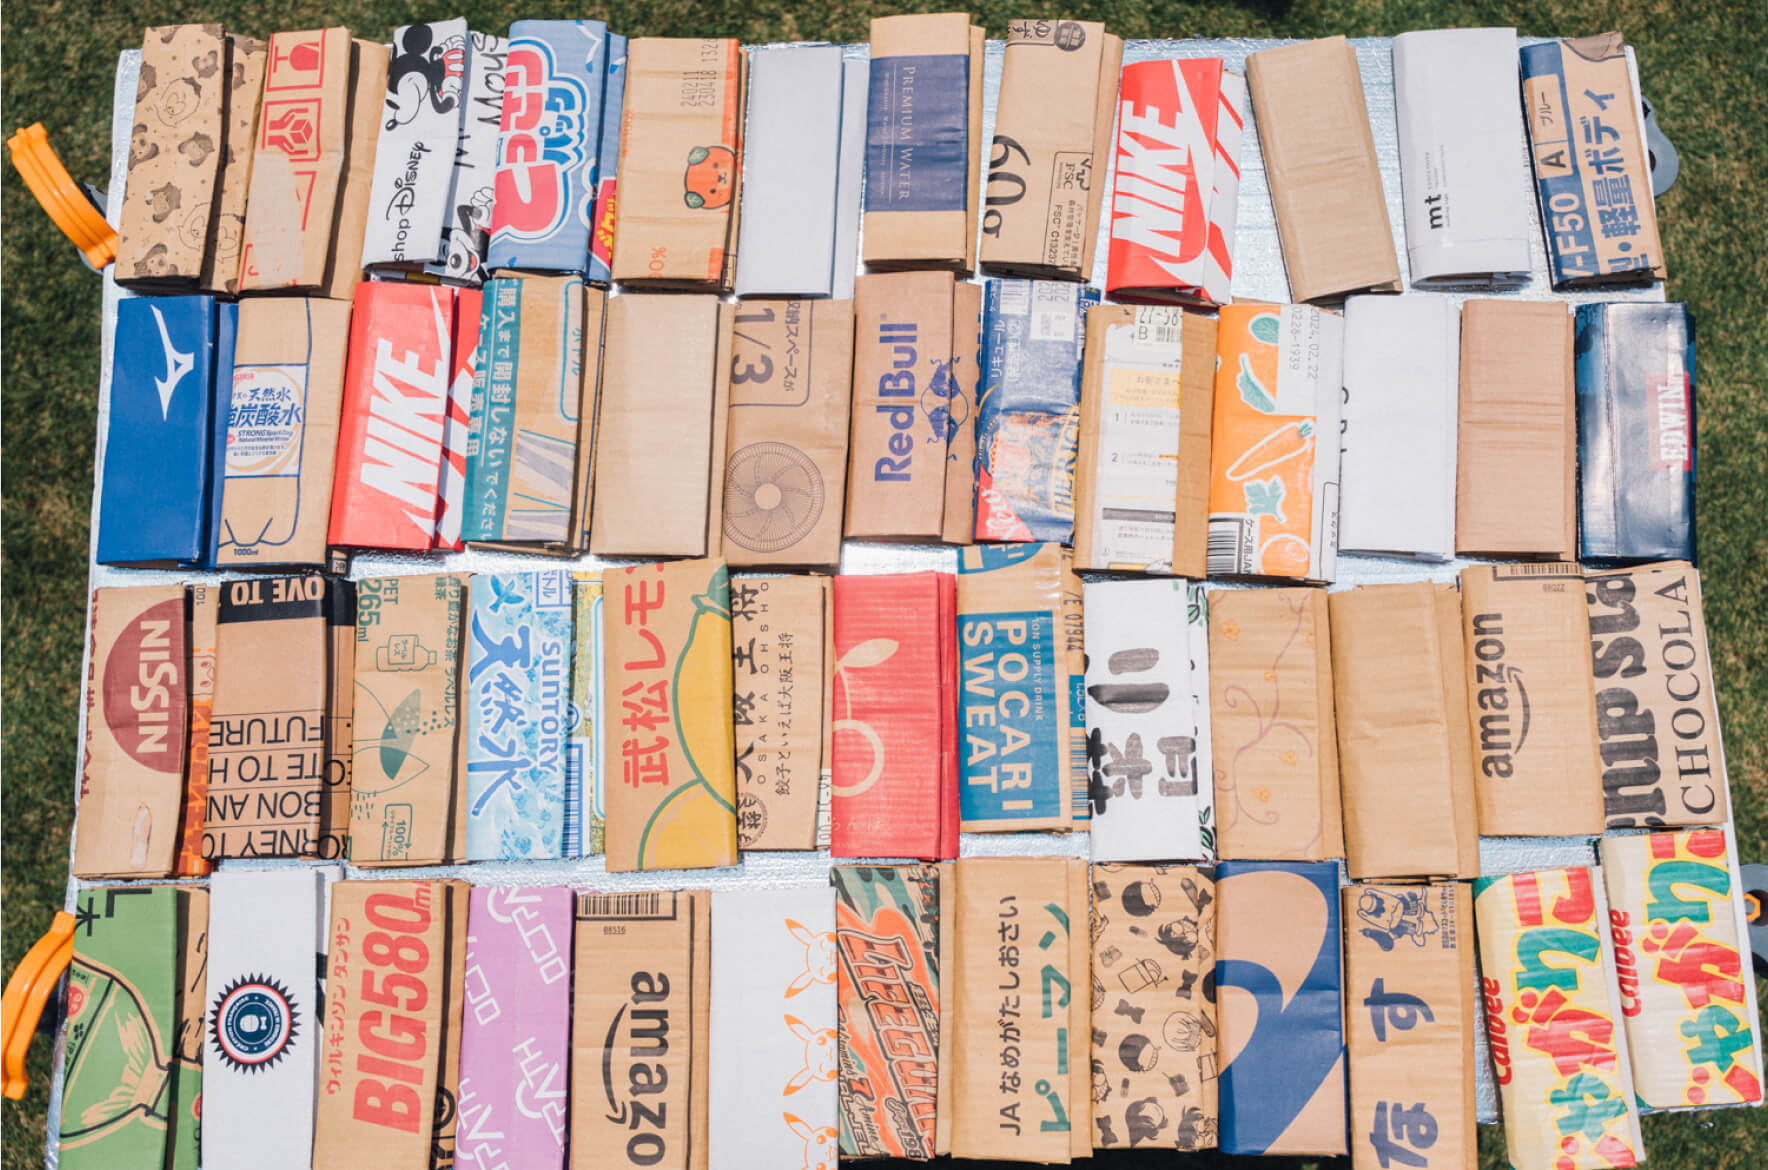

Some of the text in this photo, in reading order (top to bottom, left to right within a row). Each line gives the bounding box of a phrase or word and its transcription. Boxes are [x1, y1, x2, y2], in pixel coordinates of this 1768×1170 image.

[538, 86, 576, 166] パック
[680, 71, 700, 107] 240211
[698, 69, 719, 107] 230418
[898, 65, 917, 201] PREMIUM WATER
[1541, 91, 1555, 127] ブルー
[385, 140, 433, 263] shop Disney
[1062, 161, 1077, 190] FSC
[1112, 99, 1190, 258] NIKE
[1424, 193, 1443, 230] mt
[1540, 150, 1566, 169] A
[731, 307, 776, 385] 1/3
[990, 319, 1006, 379] リキュール
[1137, 326, 1149, 341] B
[360, 336, 447, 512] NIKE
[1660, 383, 1689, 462] EDWIN
[231, 584, 266, 606] TO
[357, 578, 382, 643] 265ml
[383, 578, 398, 605] PET
[434, 576, 447, 600] 緑茶
[130, 619, 178, 755] NISSIN
[467, 609, 532, 817] 天然水
[538, 641, 561, 774] SUNTORY
[757, 581, 770, 785] OSAKA OHSHO
[774, 632, 795, 797] 餃子といえば大阪王将
[962, 620, 1000, 794] SWEAT
[995, 619, 1034, 811] POCARI
[1031, 616, 1044, 722] ION SUPPLY DRINK
[1472, 612, 1513, 779] amazon
[1653, 575, 1716, 816] CHOCOLA
[209, 714, 324, 747] FUTURE
[237, 756, 279, 782] TO
[392, 819, 407, 857] 100%
[325, 916, 351, 1095] ウィルキンソン タンサン
[996, 895, 1021, 1137] JA なめがたしおさい
[1609, 907, 1642, 1018] Calbee
[626, 970, 671, 1167] amazo
[1363, 977, 1440, 1169] なす
[1482, 976, 1513, 1086] Calbee
